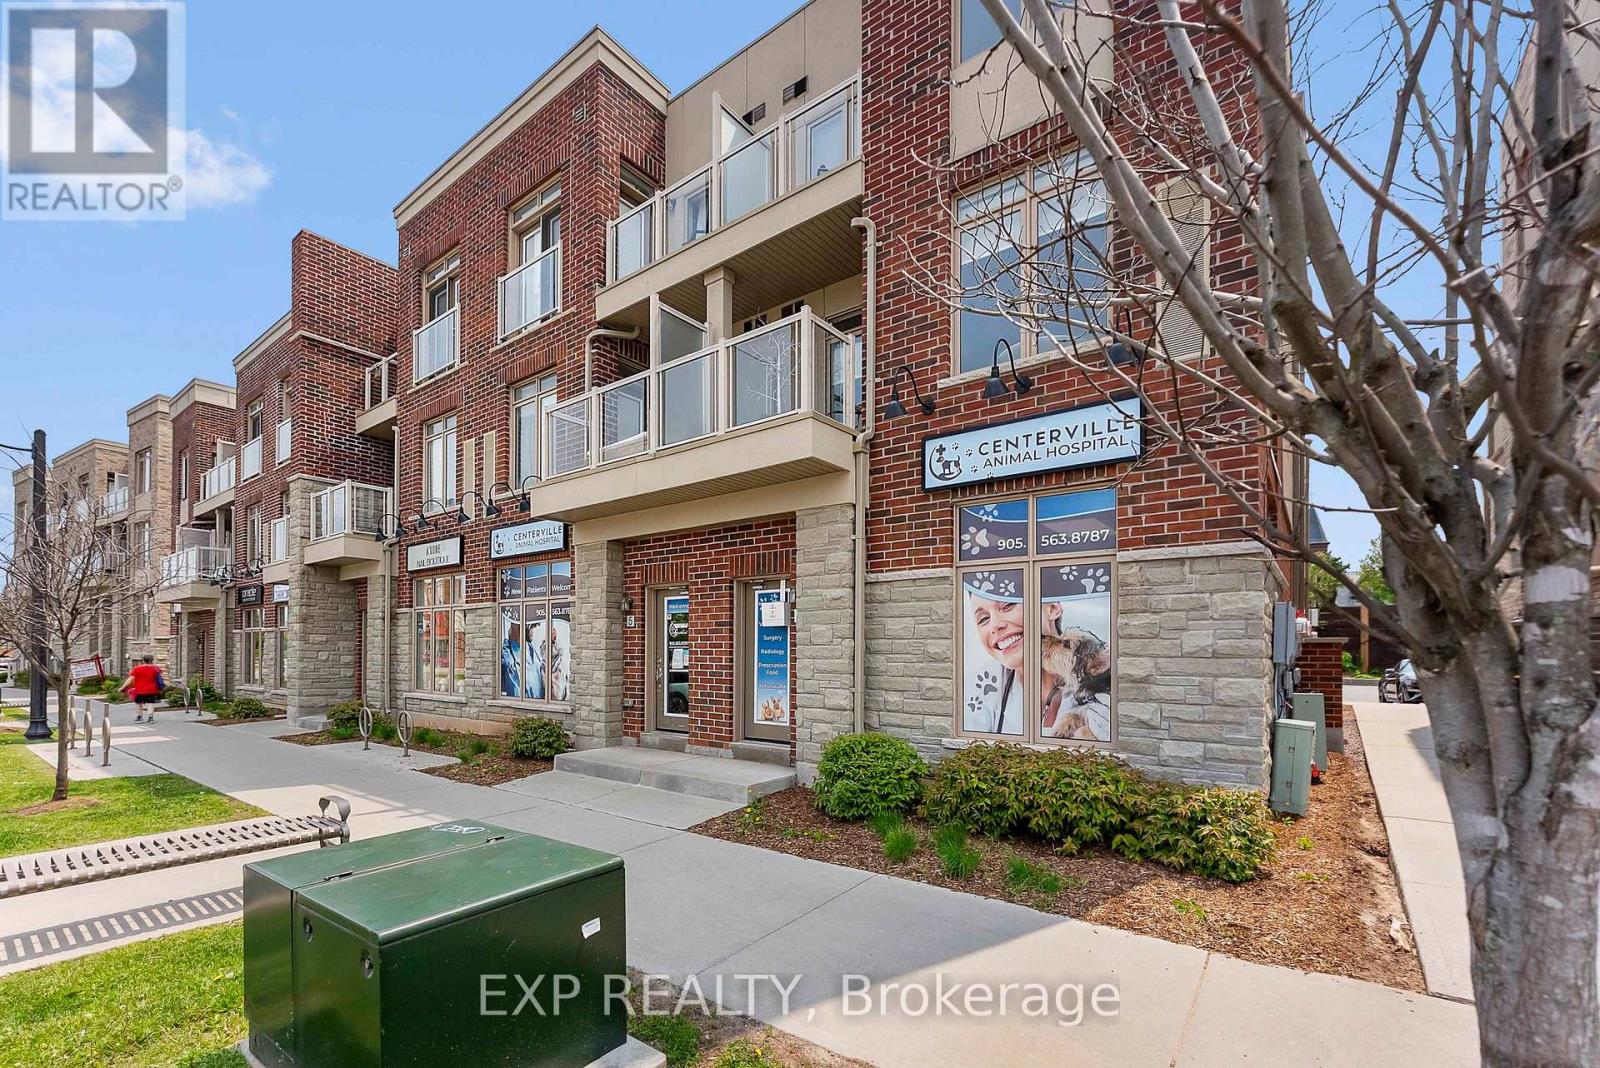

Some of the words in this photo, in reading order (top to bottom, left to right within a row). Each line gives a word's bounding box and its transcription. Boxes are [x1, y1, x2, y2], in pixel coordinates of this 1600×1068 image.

[978, 414, 1135, 456] CENTERVILLE
[983, 449, 1042, 470] ANIMAL
[1046, 434, 1129, 459] HOSPITAL
[513, 525, 563, 542] CENTERVILLE
[997, 538, 1027, 551] 905.
[1040, 529, 1110, 548] 563.8787
[515, 540, 535, 549] ANIMAL
[534, 536, 561, 546] HOSPITAL
[526, 585, 547, 594] Patients
[551, 584, 571, 592] Welcom
[763, 634, 783, 642] Surgery
[760, 648, 785, 656] Radiology
[758, 662, 788, 670] Prescription
